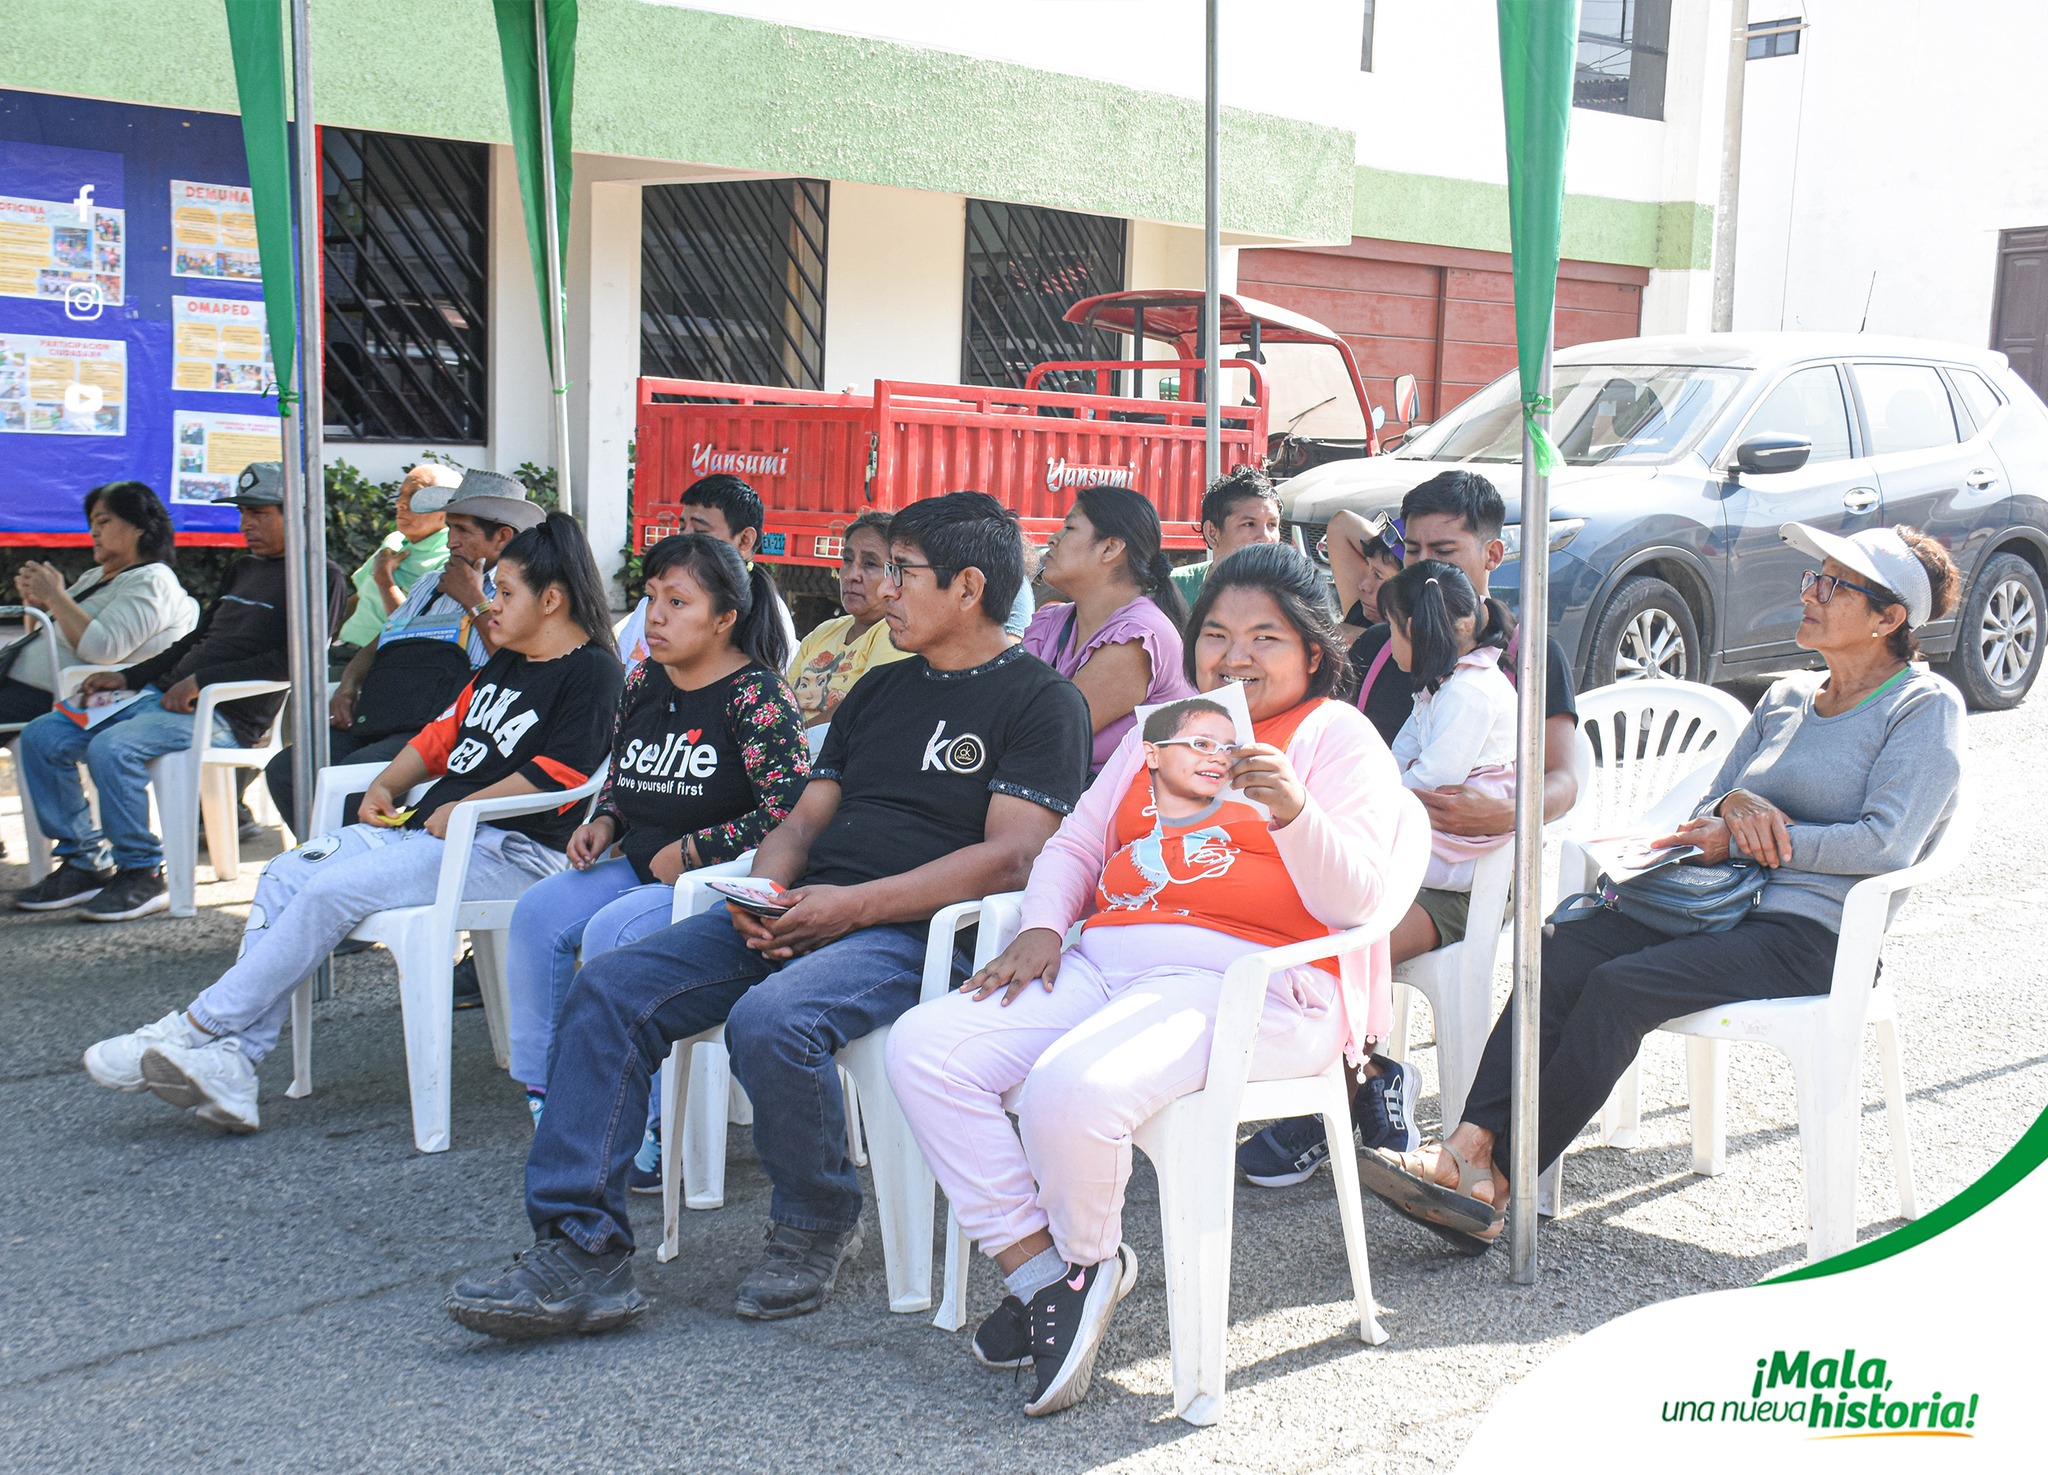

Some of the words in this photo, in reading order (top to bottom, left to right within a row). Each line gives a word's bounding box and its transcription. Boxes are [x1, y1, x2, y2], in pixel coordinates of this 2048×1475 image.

[187, 301, 250, 316] OMAPED
[691, 442, 789, 476] Yansumi
[1046, 457, 1135, 492] Yansumi
[620, 728, 718, 778] selfie
[617, 773, 635, 789] love
[636, 780, 674, 793] yourself
[677, 781, 704, 796] first
[1046, 1304, 1056, 1345] AIR
